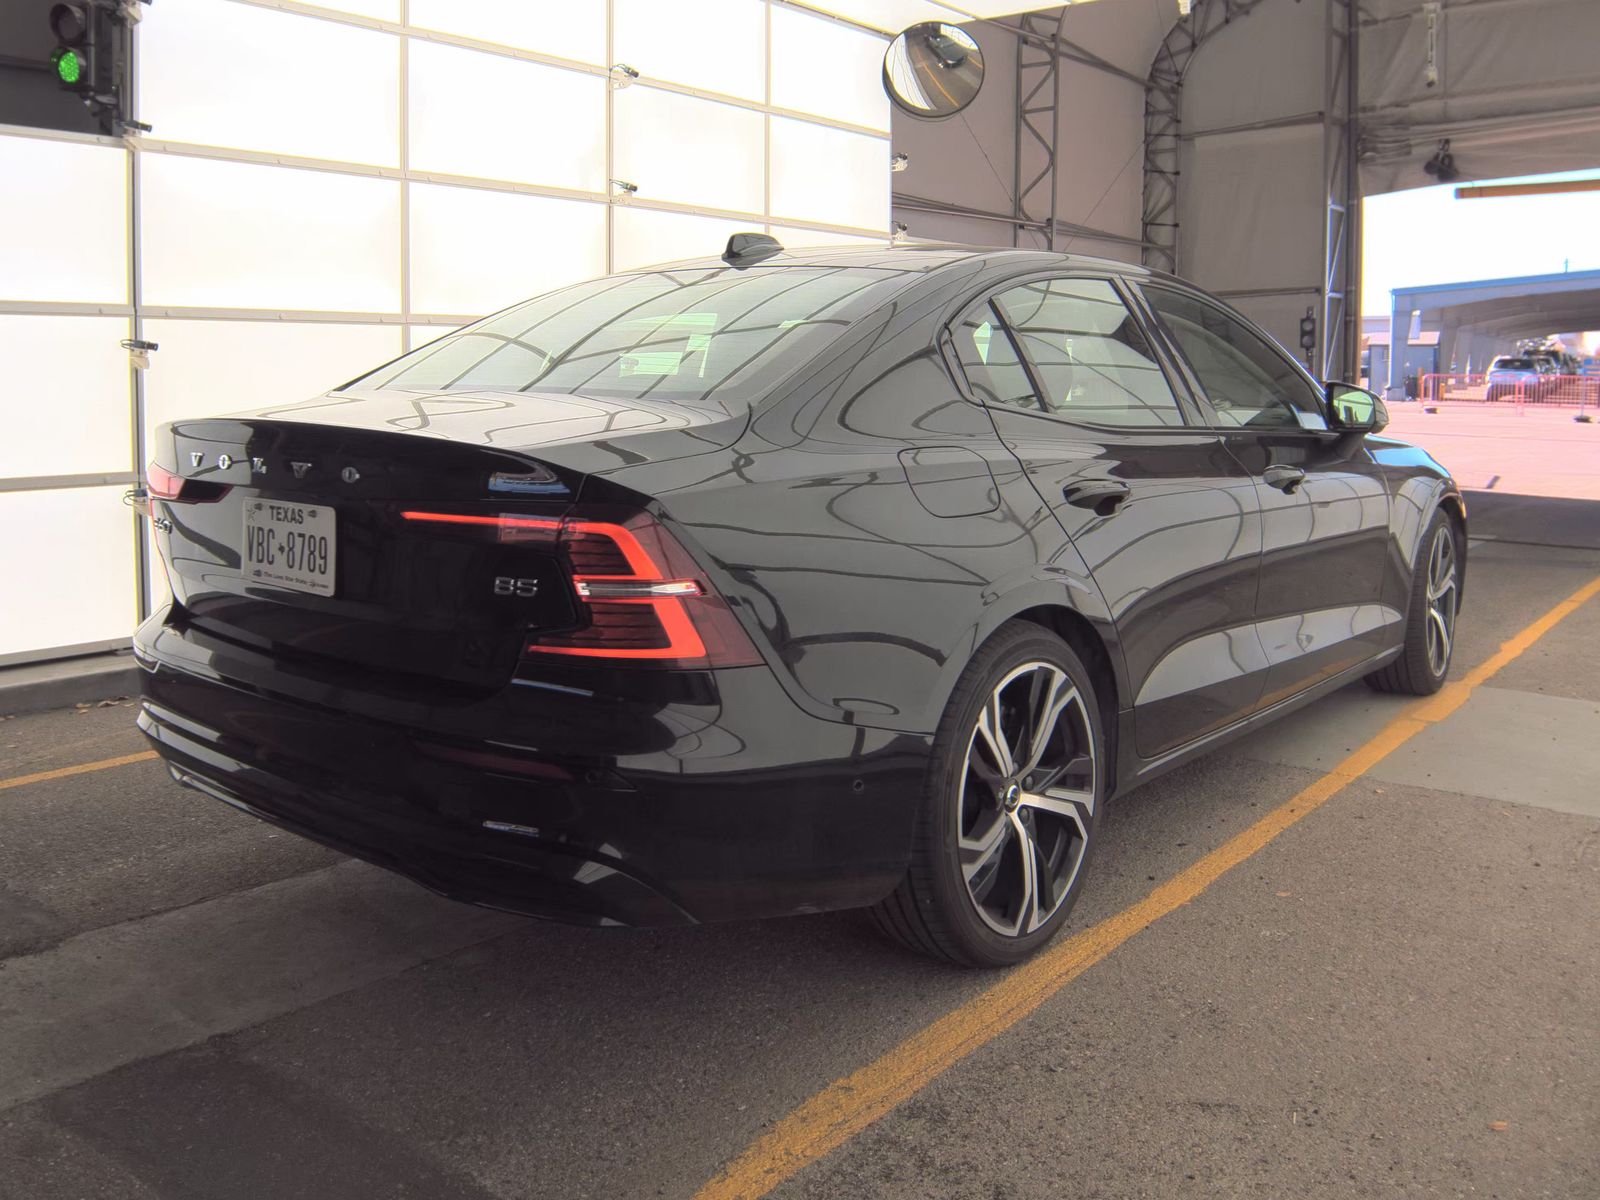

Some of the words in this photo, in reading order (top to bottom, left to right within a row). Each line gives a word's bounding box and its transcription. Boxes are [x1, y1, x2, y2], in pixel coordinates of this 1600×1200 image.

[190, 452, 360, 484] VOLVO
[269, 505, 304, 525] TEXAS
[247, 525, 275, 566] VBC
[286, 531, 328, 576] 8789
[495, 576, 538, 597] B5
